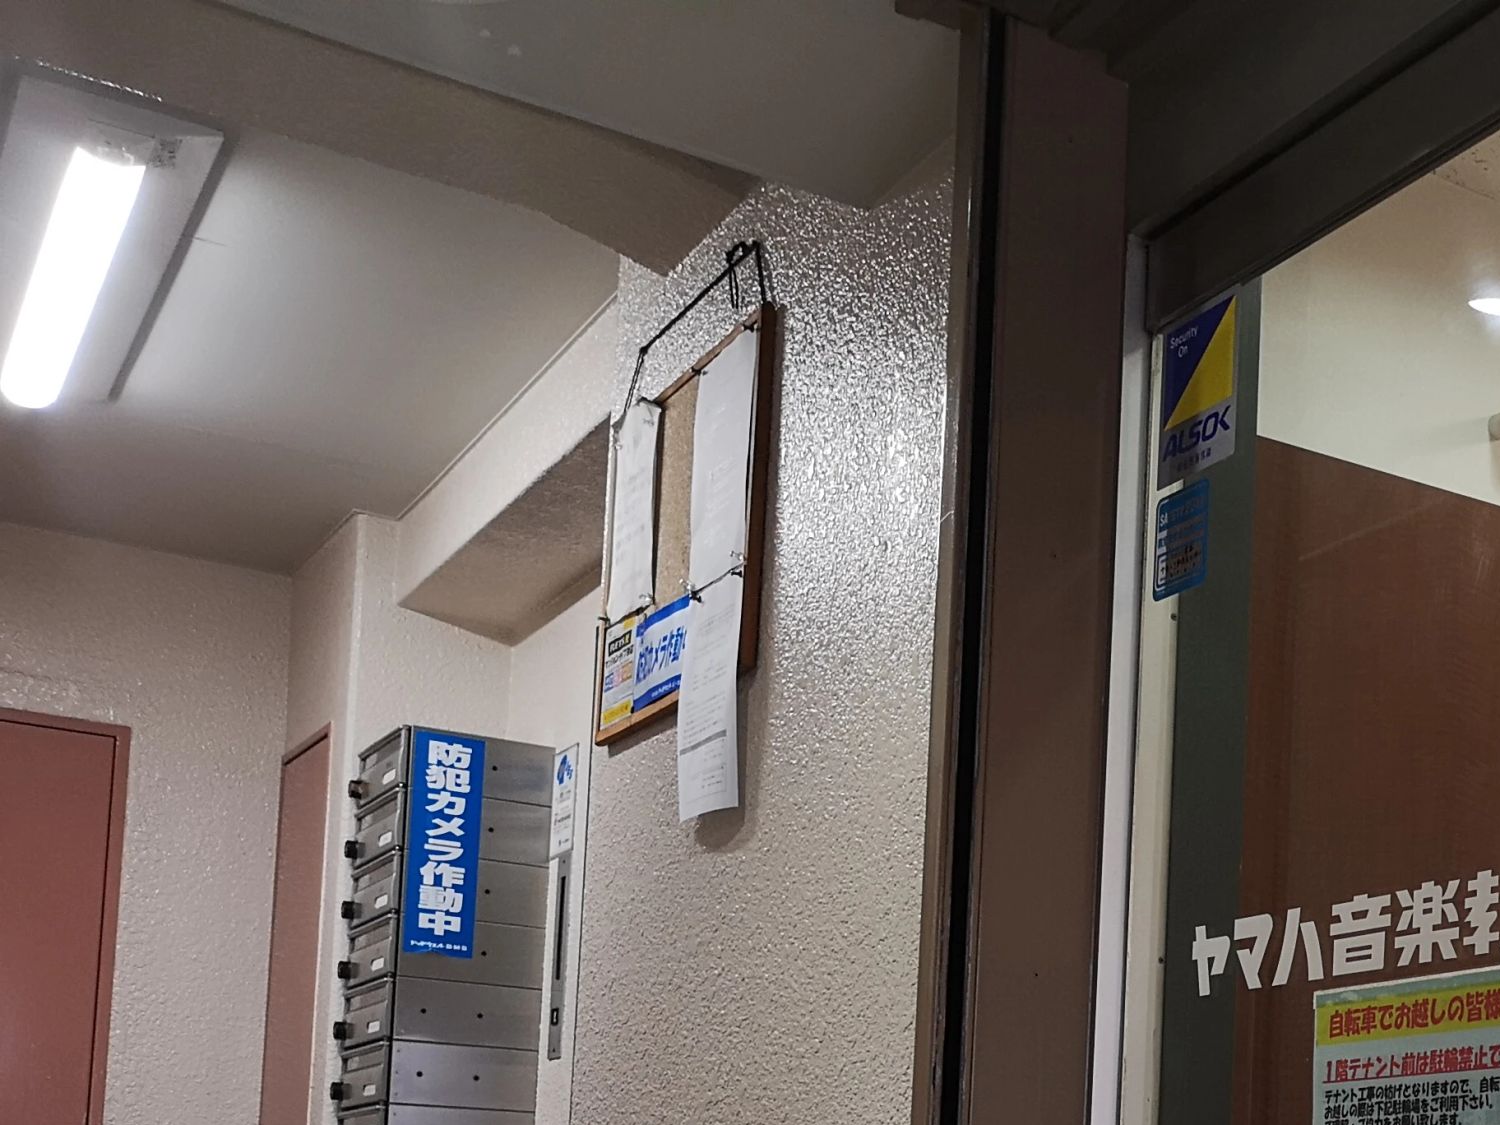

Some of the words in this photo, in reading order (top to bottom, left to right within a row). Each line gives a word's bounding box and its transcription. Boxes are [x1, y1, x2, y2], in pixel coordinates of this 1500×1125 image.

[1169, 325, 1199, 350] Security
[1178, 345, 1188, 358] On
[1162, 405, 1231, 463] ALSOK
[417, 739, 473, 937] 防犯カメラ作動中
